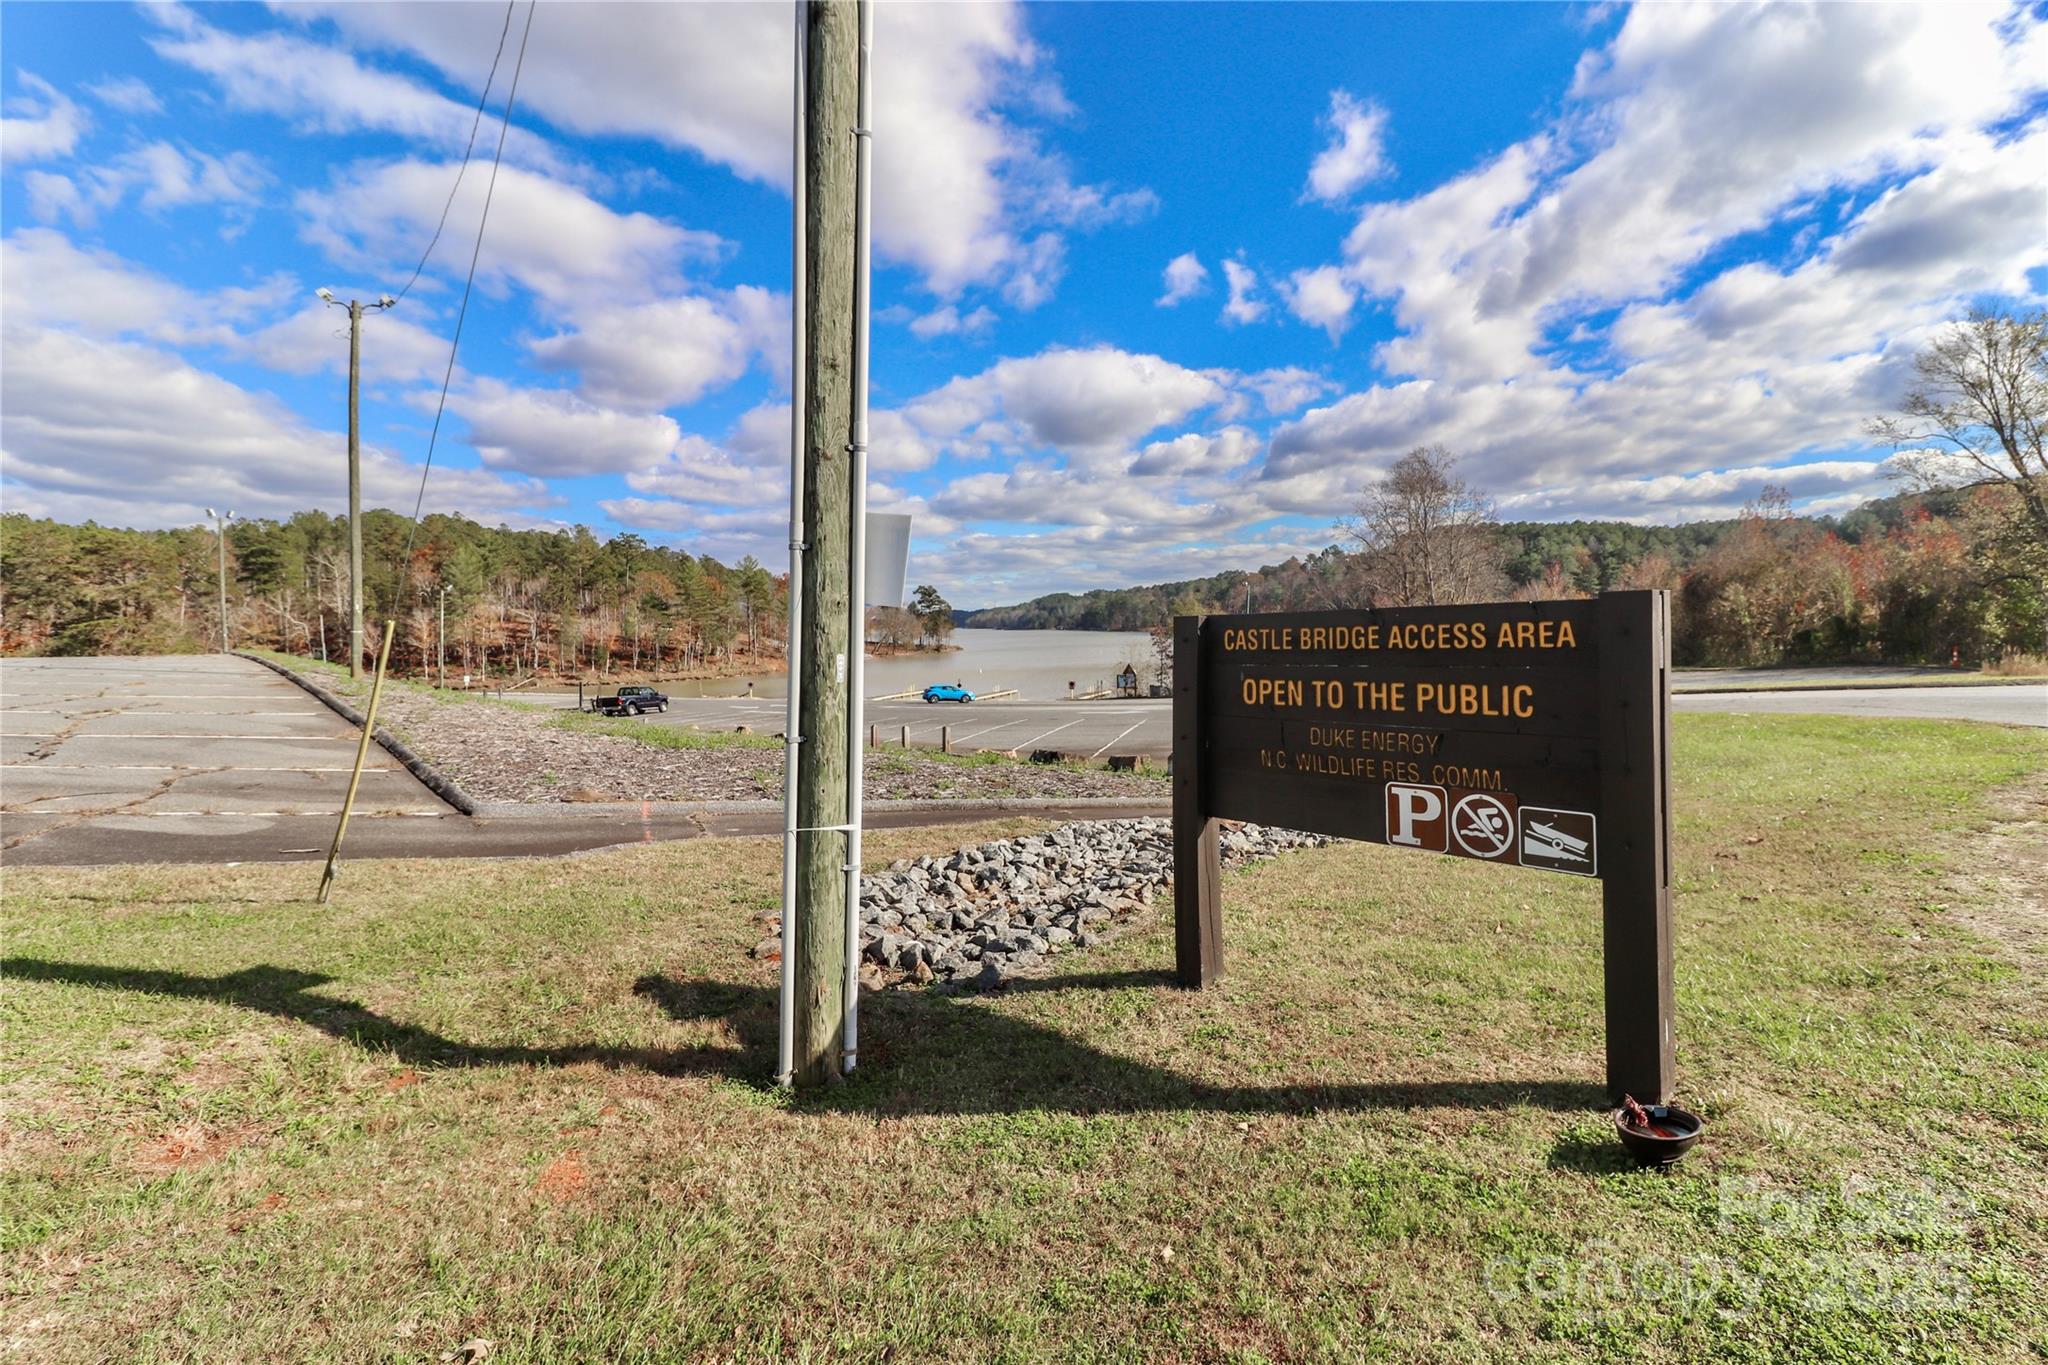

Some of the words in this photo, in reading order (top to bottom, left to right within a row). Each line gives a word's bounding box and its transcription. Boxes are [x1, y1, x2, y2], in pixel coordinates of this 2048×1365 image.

[1224, 628, 1292, 650] CASTLE
[1300, 625, 1380, 650] BRIDGE
[1388, 622, 1487, 649] ACCESS
[1497, 620, 1576, 648] AREA
[1242, 678, 1303, 707] OPEN
[1311, 680, 1343, 709] TO
[1353, 681, 1405, 711] THE
[1416, 683, 1534, 718] PUBLIC
[1310, 726, 1355, 749] DUKE
[1361, 730, 1439, 755] ENERGY
[1295, 753, 1376, 778] WILDLIFE
[1432, 764, 1508, 792] COMM.
[1391, 786, 1442, 846] P
